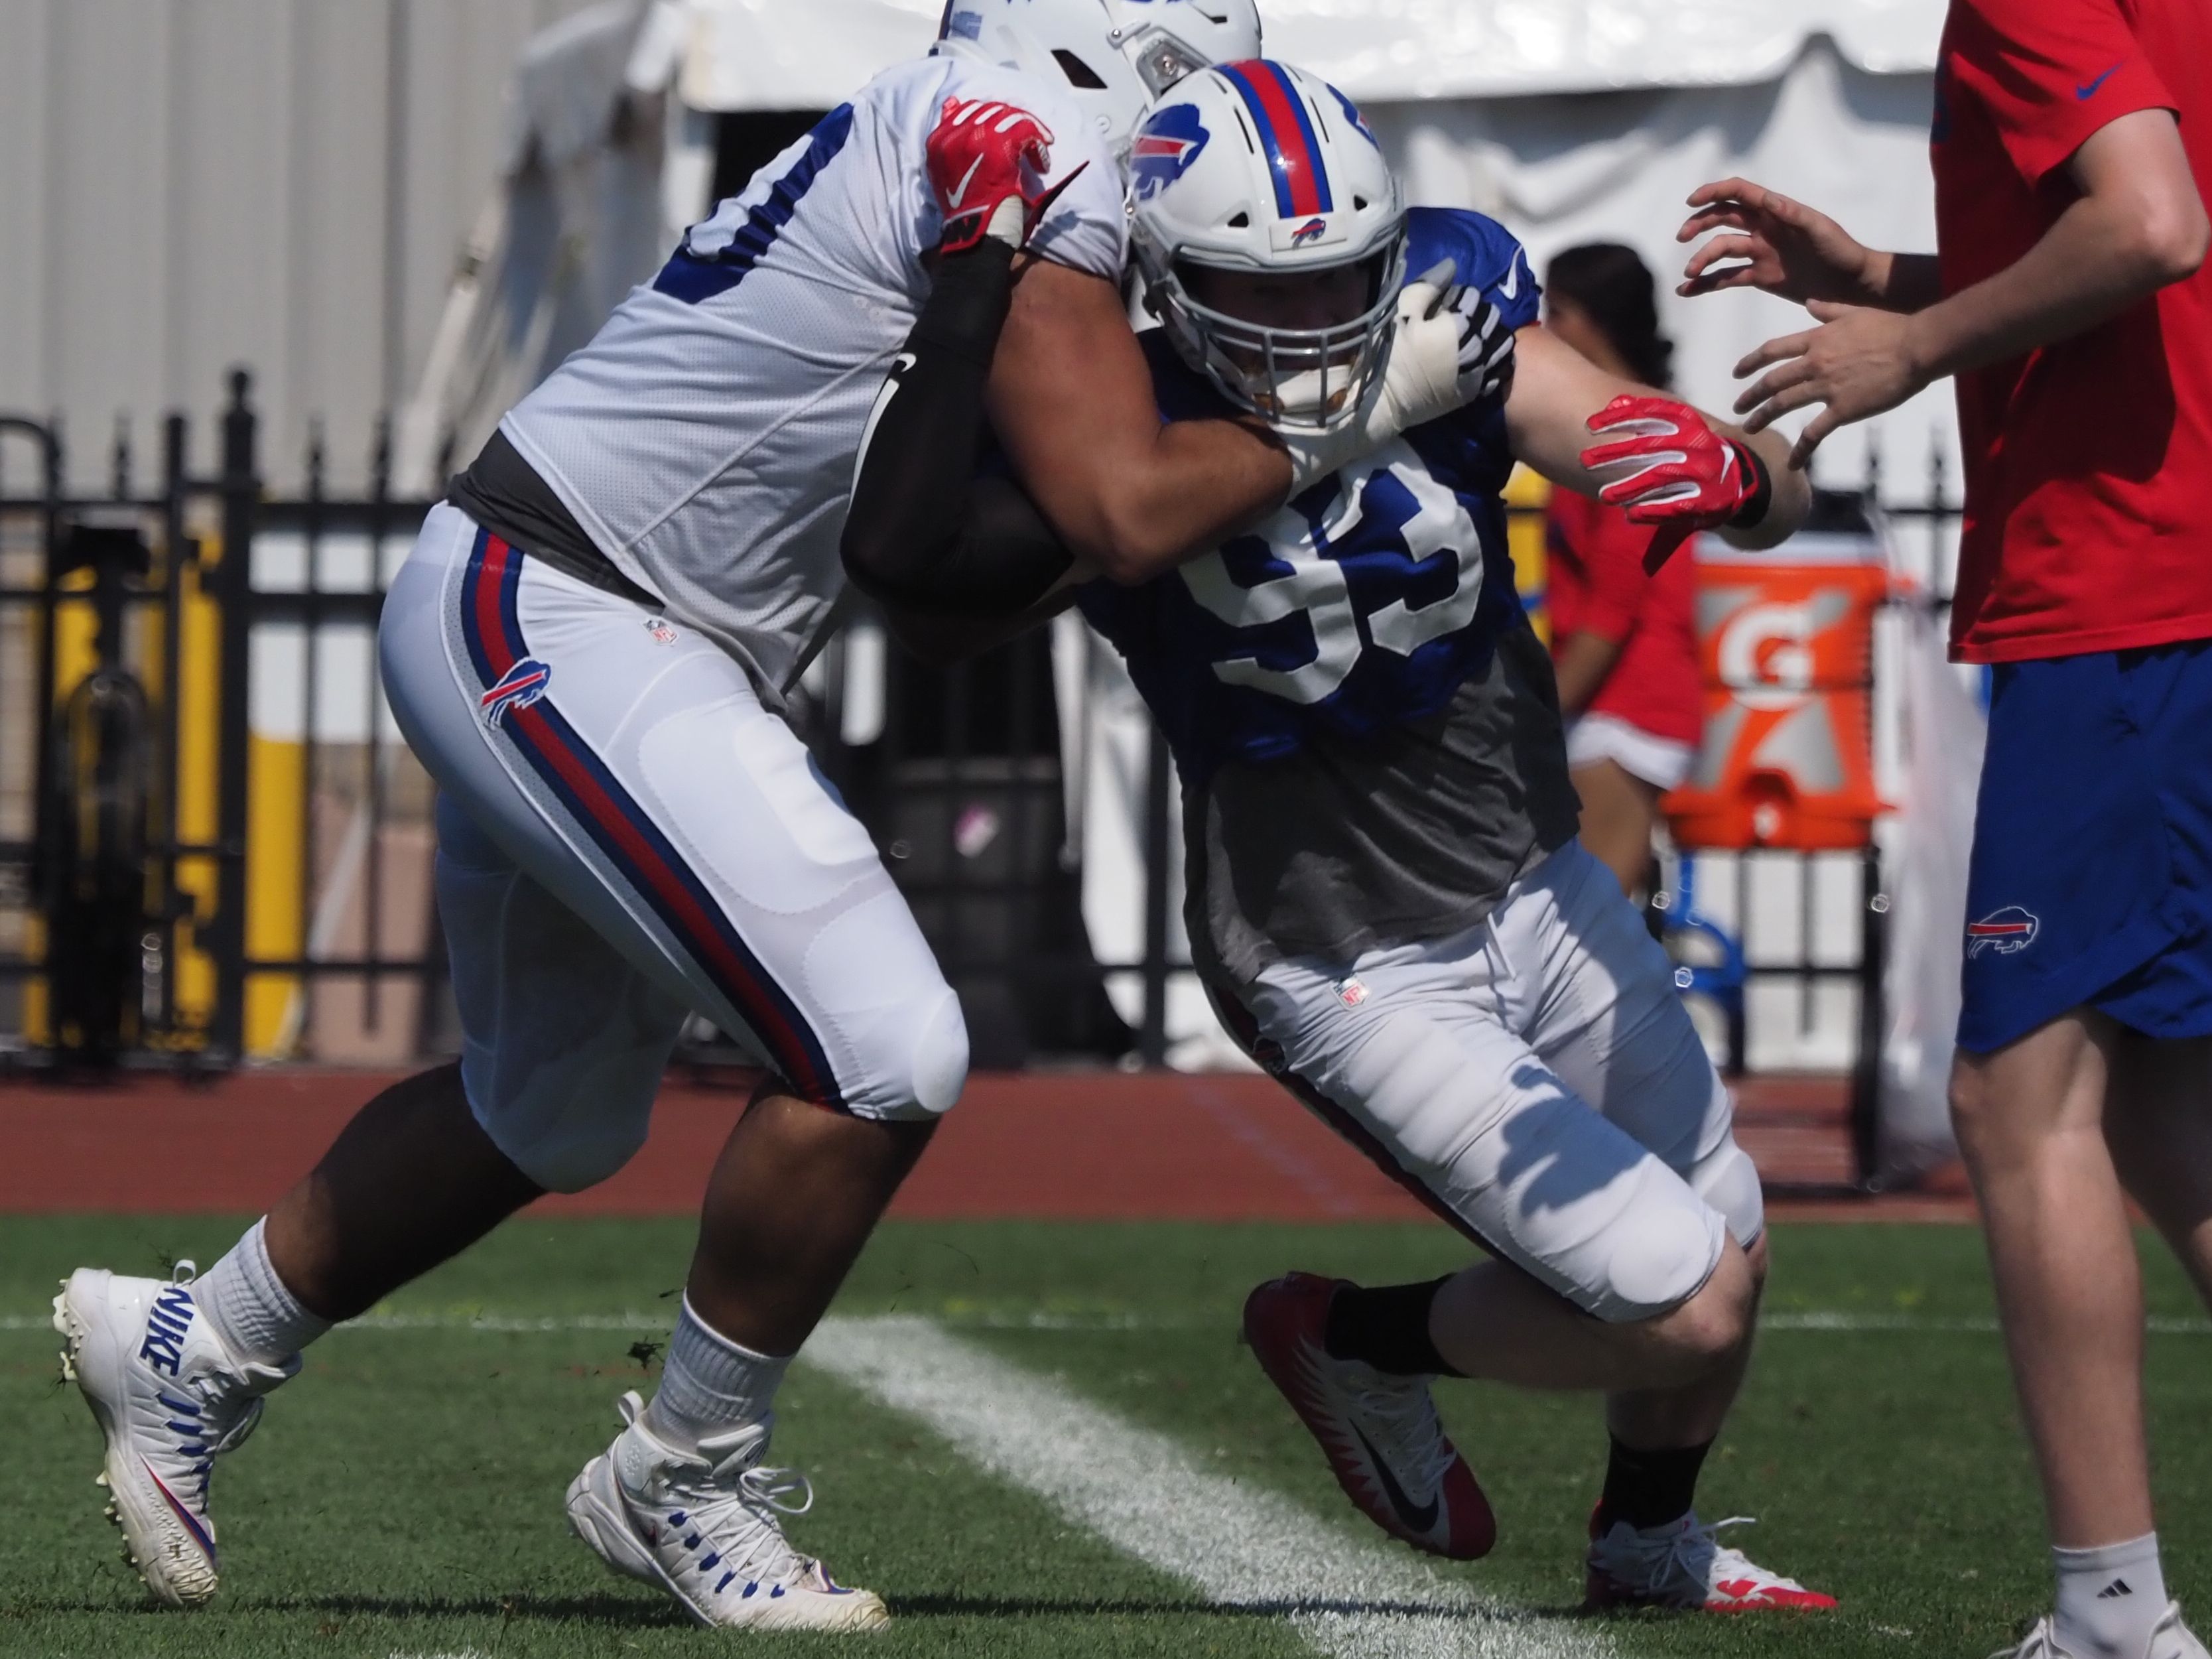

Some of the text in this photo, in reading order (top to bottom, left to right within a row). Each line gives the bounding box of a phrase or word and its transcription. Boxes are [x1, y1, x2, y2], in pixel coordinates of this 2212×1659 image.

[1178, 436, 1484, 705] 93
[1719, 608, 1815, 711] G
[139, 1288, 195, 1377] NIKE
